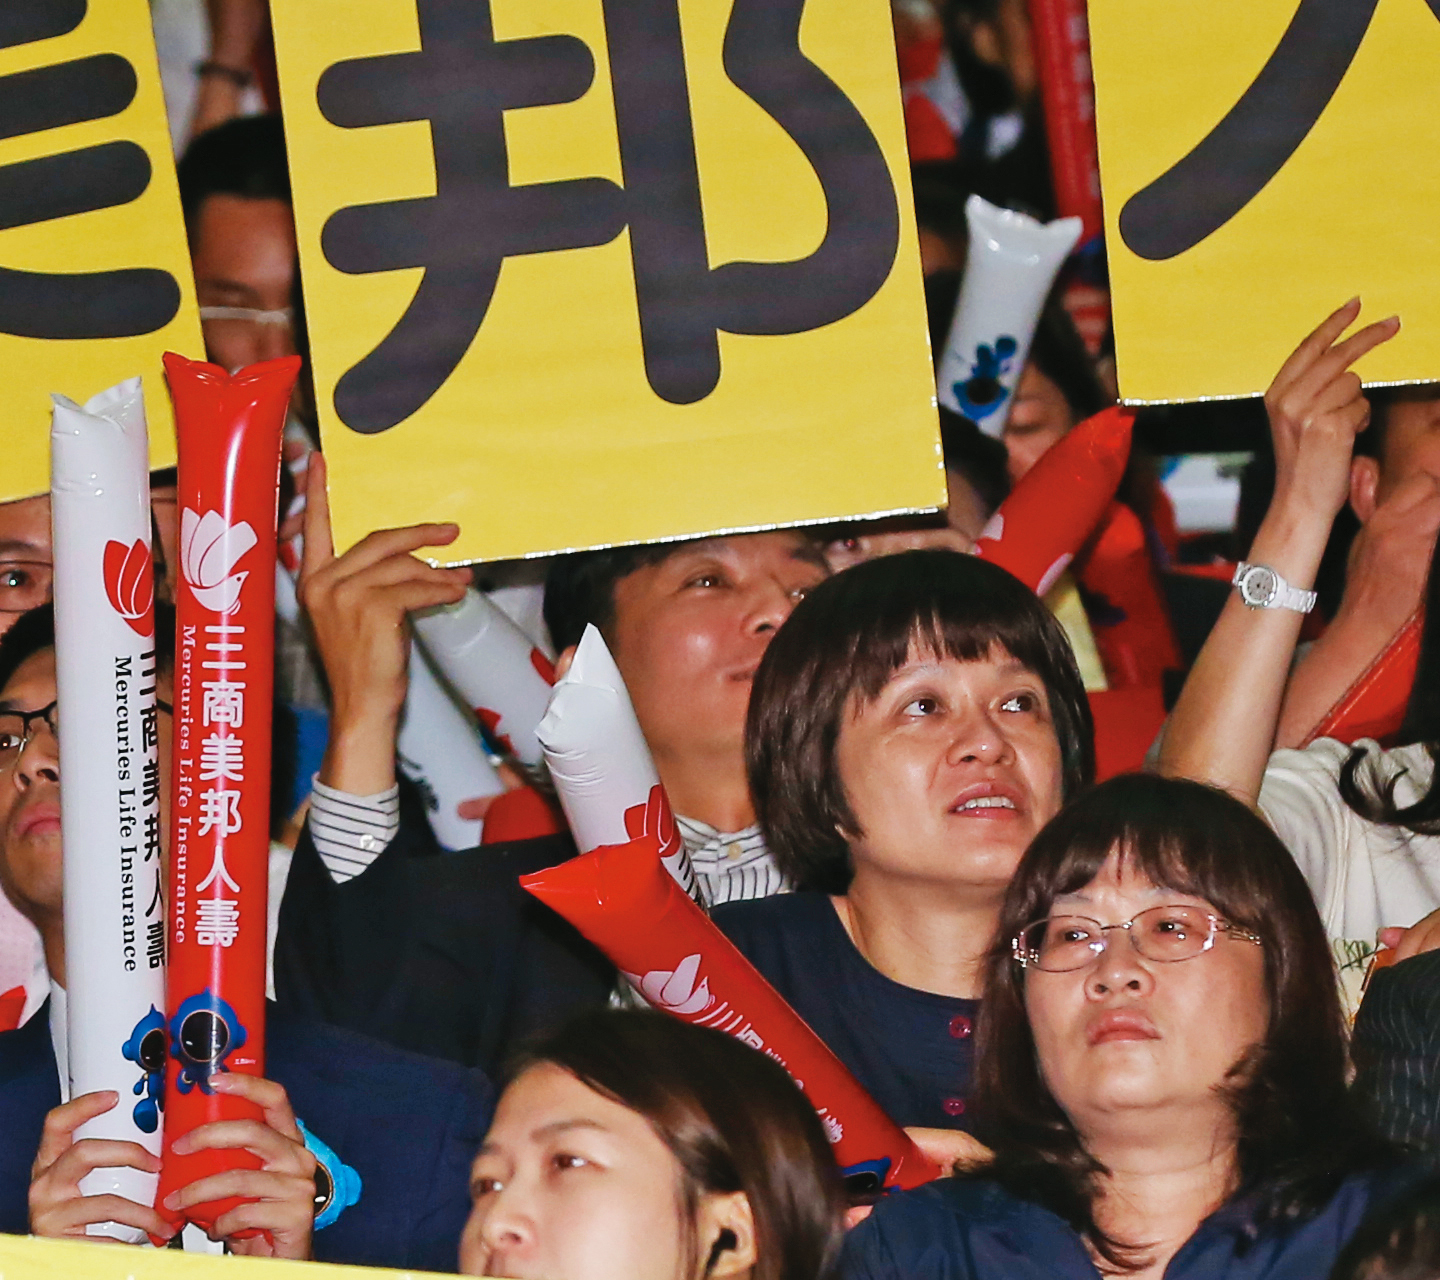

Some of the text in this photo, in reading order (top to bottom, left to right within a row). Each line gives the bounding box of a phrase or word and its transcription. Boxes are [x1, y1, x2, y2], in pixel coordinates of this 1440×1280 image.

[114, 655, 138, 972] Mercuries Life Insurance
[174, 624, 196, 945] Mercuries Life Insurance
[195, 625, 247, 947] 三商美邦人壽
